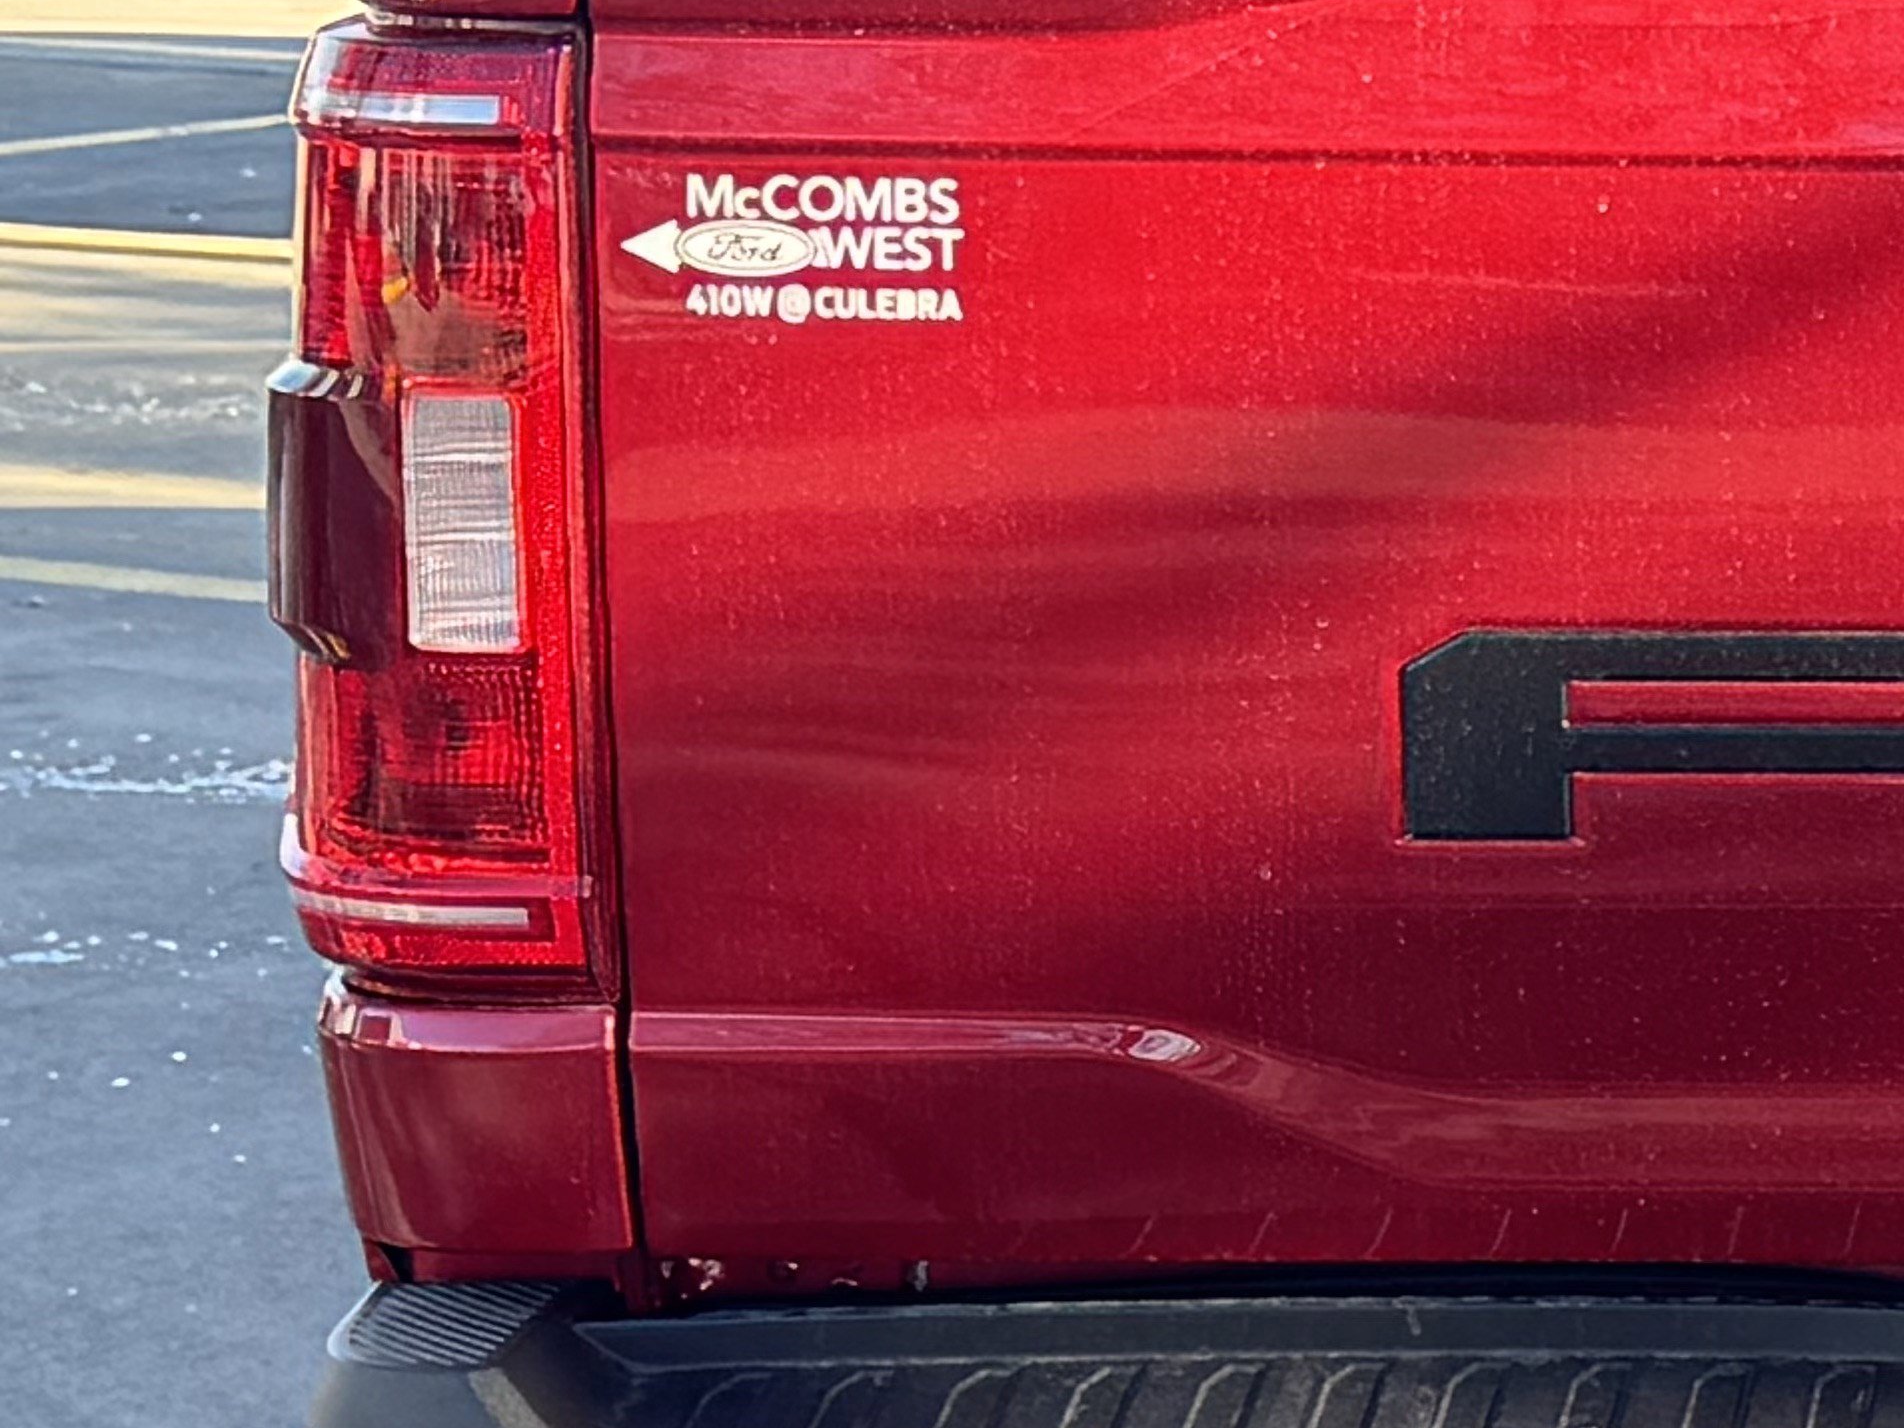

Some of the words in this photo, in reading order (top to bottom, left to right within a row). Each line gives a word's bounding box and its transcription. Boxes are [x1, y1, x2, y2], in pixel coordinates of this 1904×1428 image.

[686, 174, 960, 224] McCOMBS
[707, 233, 782, 261] Ford
[825, 226, 965, 271] WEST
